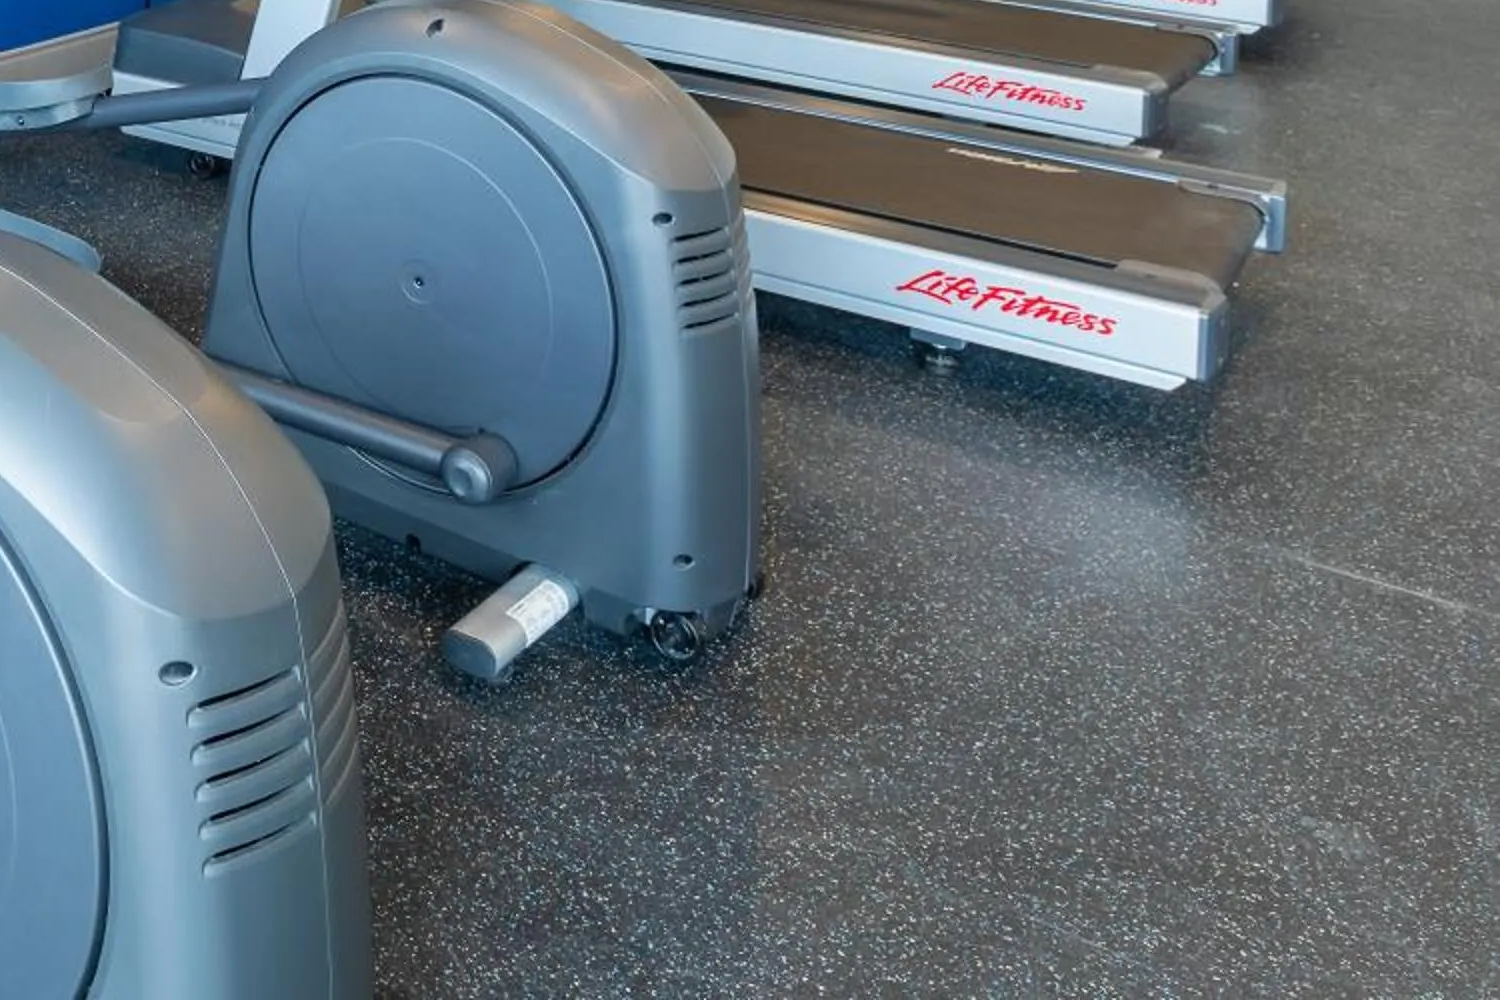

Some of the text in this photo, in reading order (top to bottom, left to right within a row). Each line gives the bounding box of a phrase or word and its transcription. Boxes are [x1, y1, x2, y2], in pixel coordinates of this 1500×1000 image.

[932, 72, 1087, 111] Life Fitness
[896, 270, 1117, 335] Life Fitness
